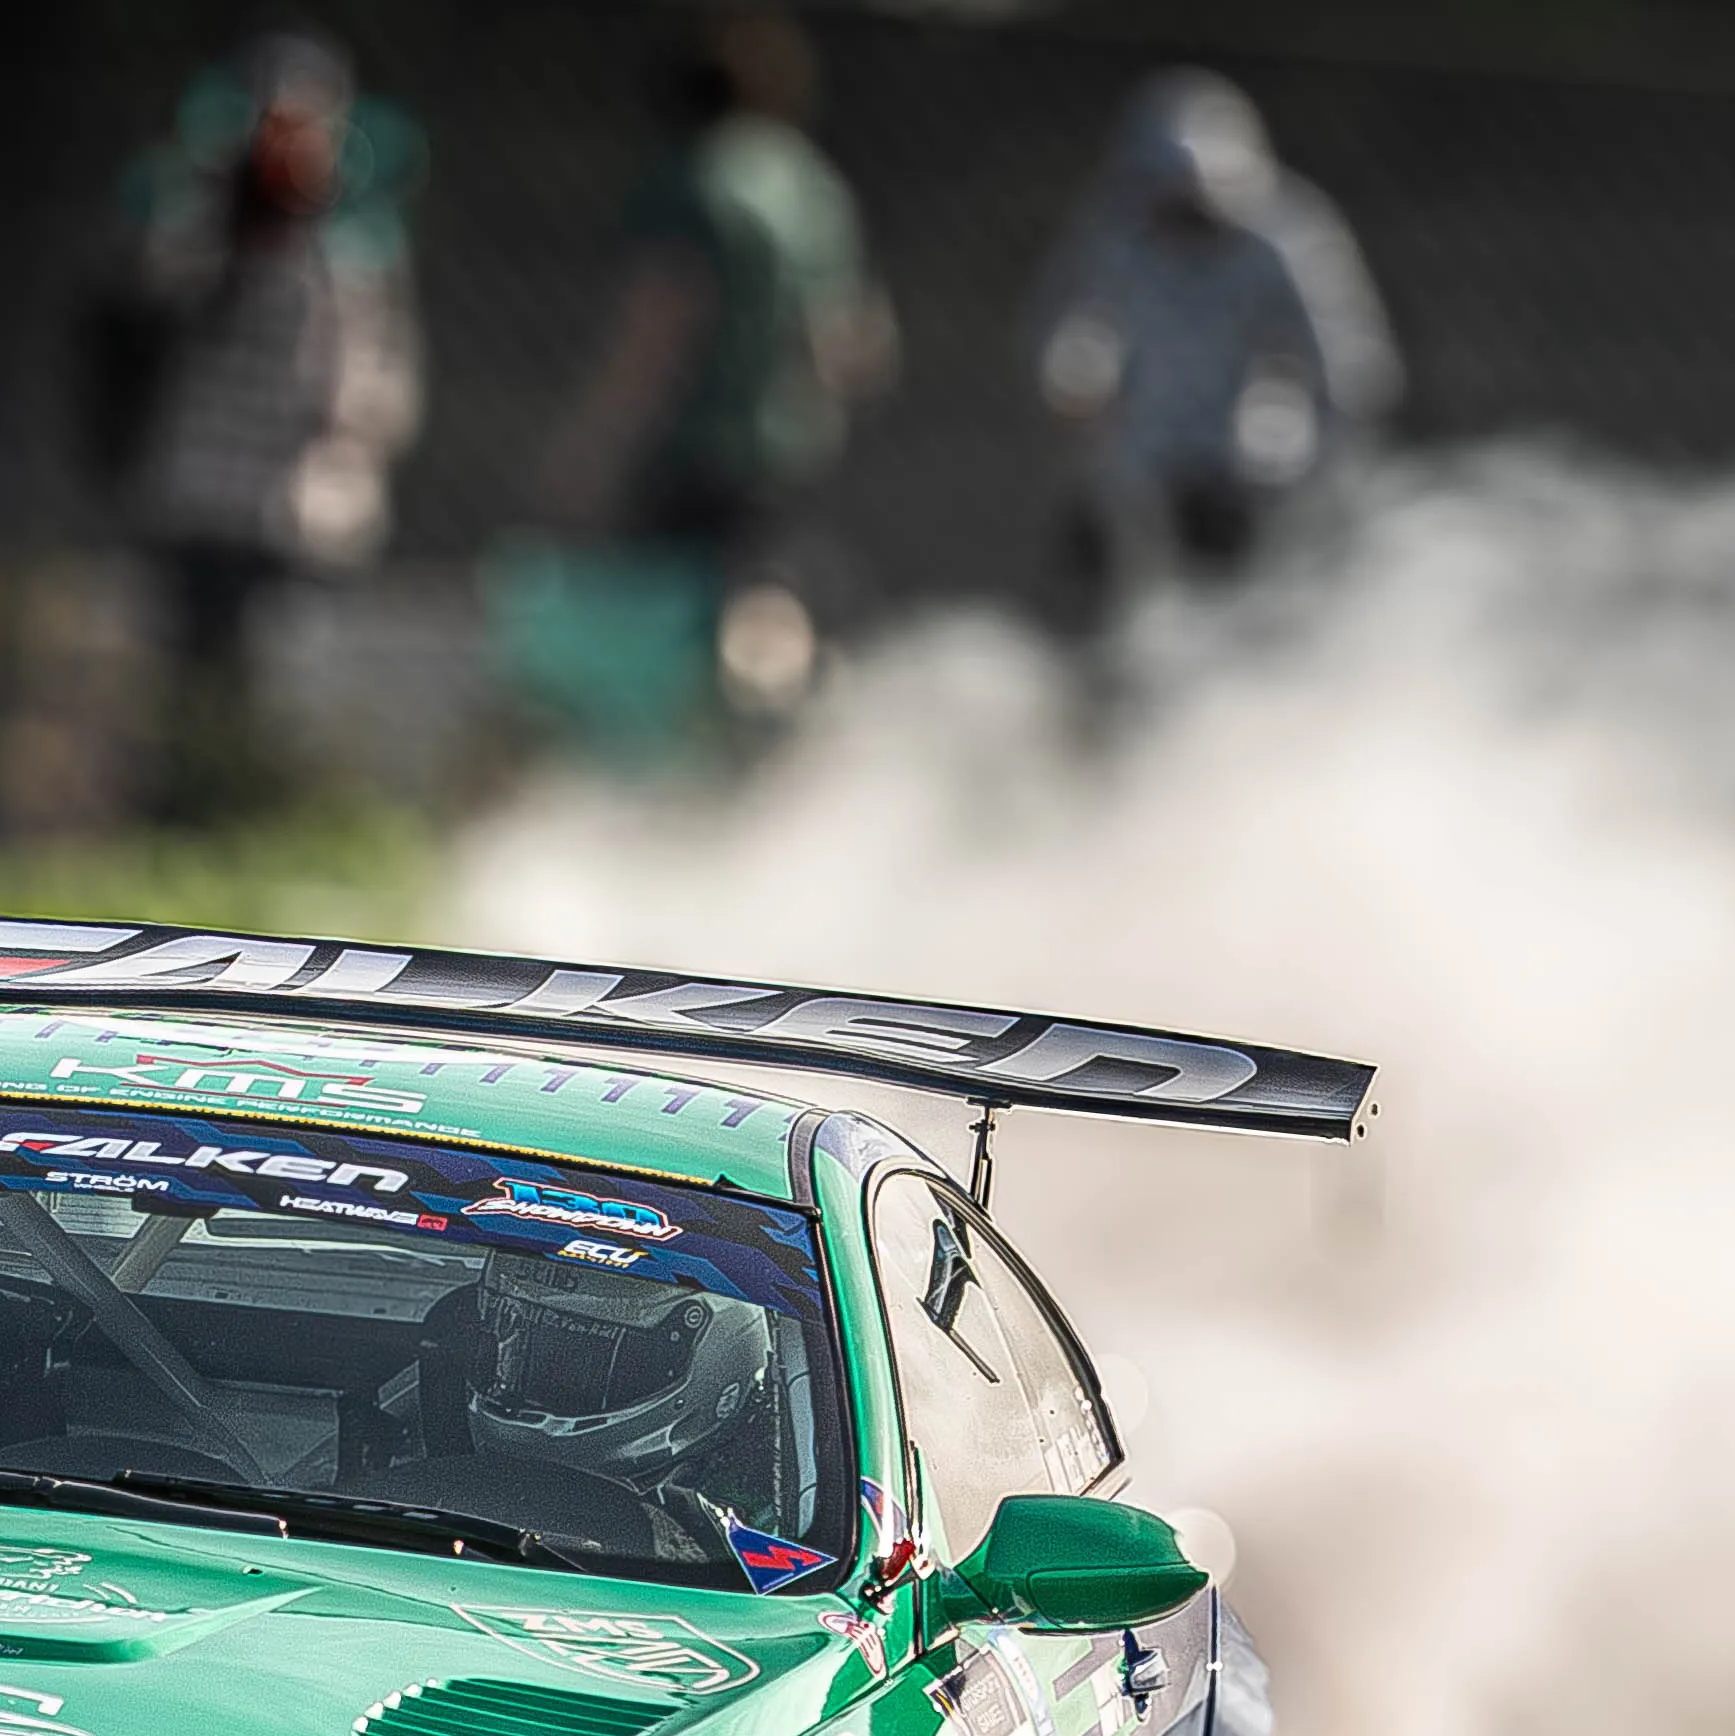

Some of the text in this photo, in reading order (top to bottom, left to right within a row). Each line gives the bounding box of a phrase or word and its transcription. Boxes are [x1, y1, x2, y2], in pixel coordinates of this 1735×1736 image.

[50, 1056, 430, 1115] KMS
[55, 1082, 92, 1094] OF
[109, 1087, 224, 1107] ENGINE
[235, 1098, 481, 1137] PERFORMANCE
[45, 1171, 169, 1192] STRÖM
[280, 1195, 418, 1226] HEATWAVE
[476, 1199, 672, 1236] SHOWDOWN
[563, 1239, 649, 1264] ECU
[500, 1611, 664, 1640] ZMS
